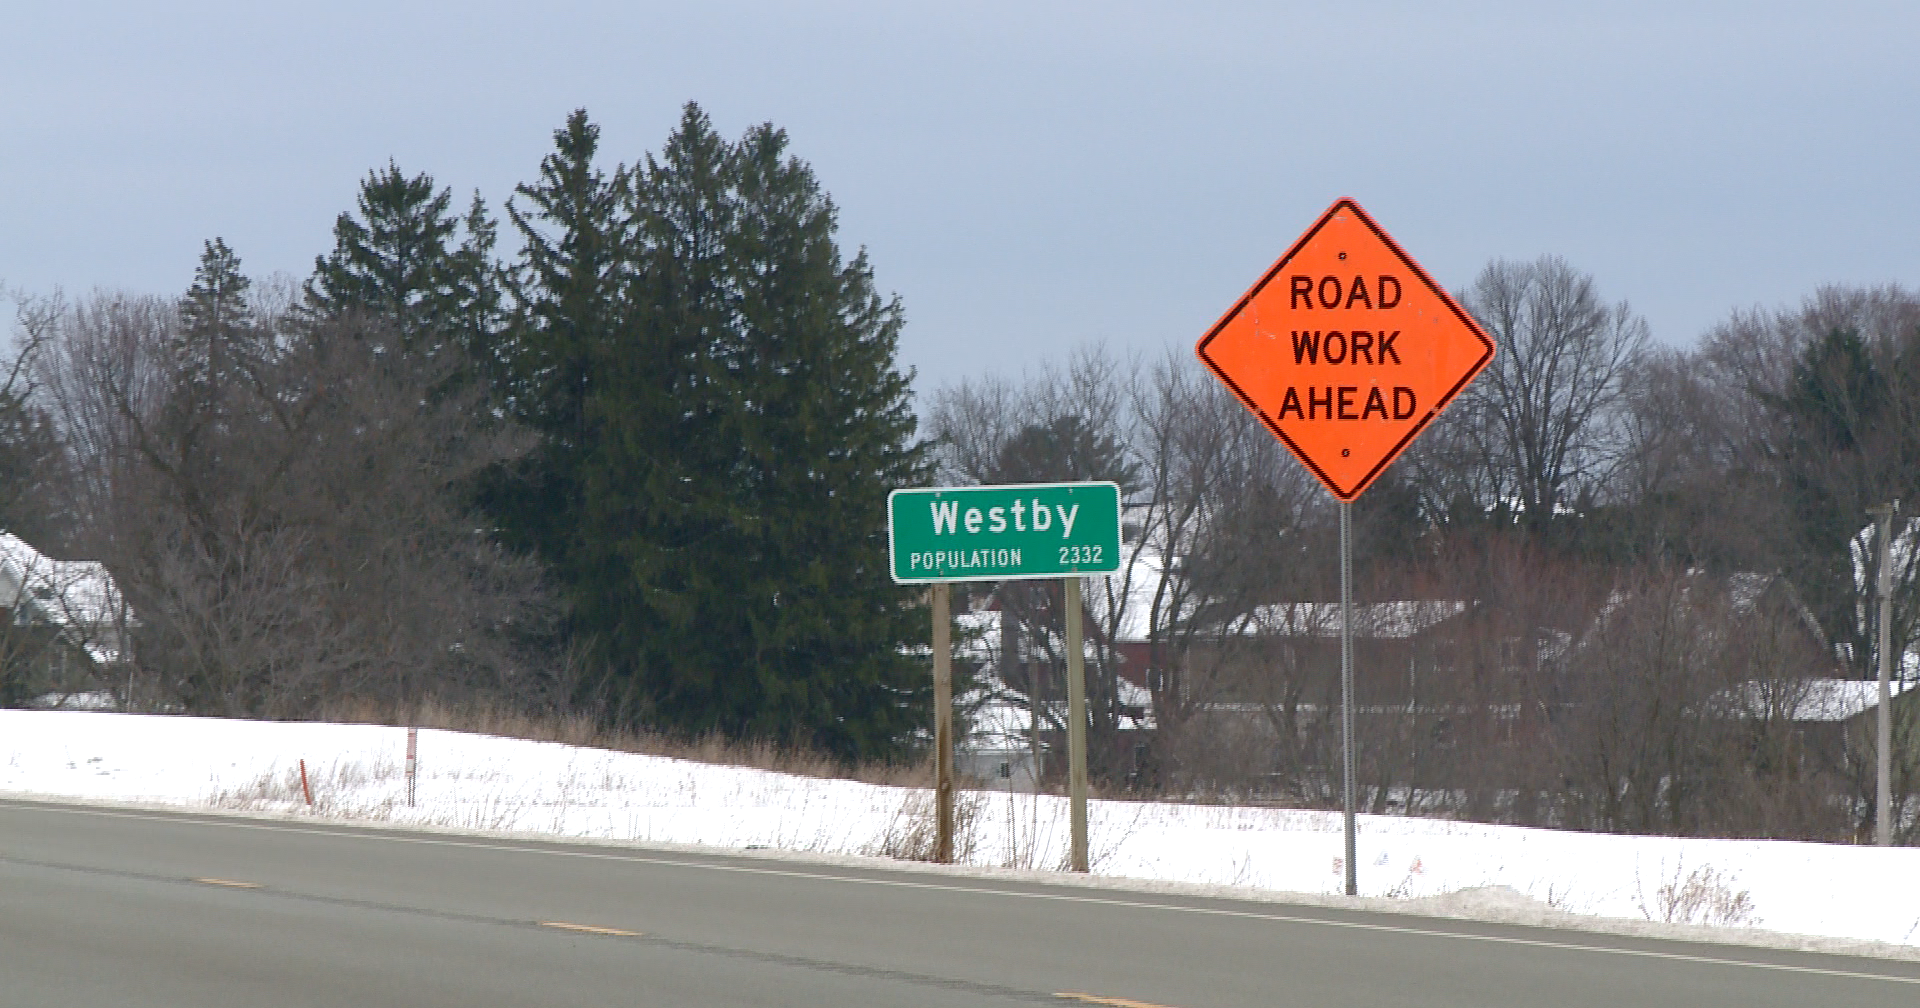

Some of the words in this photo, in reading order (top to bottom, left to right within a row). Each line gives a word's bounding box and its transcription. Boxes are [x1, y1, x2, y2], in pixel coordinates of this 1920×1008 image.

[1291, 276, 1402, 309] ROAD
[1291, 331, 1401, 365] WORK
[1277, 386, 1417, 419] AHEAD
[930, 498, 1079, 539] Westby
[910, 549, 1021, 570] POPULATION
[1058, 544, 1104, 565] 2332
